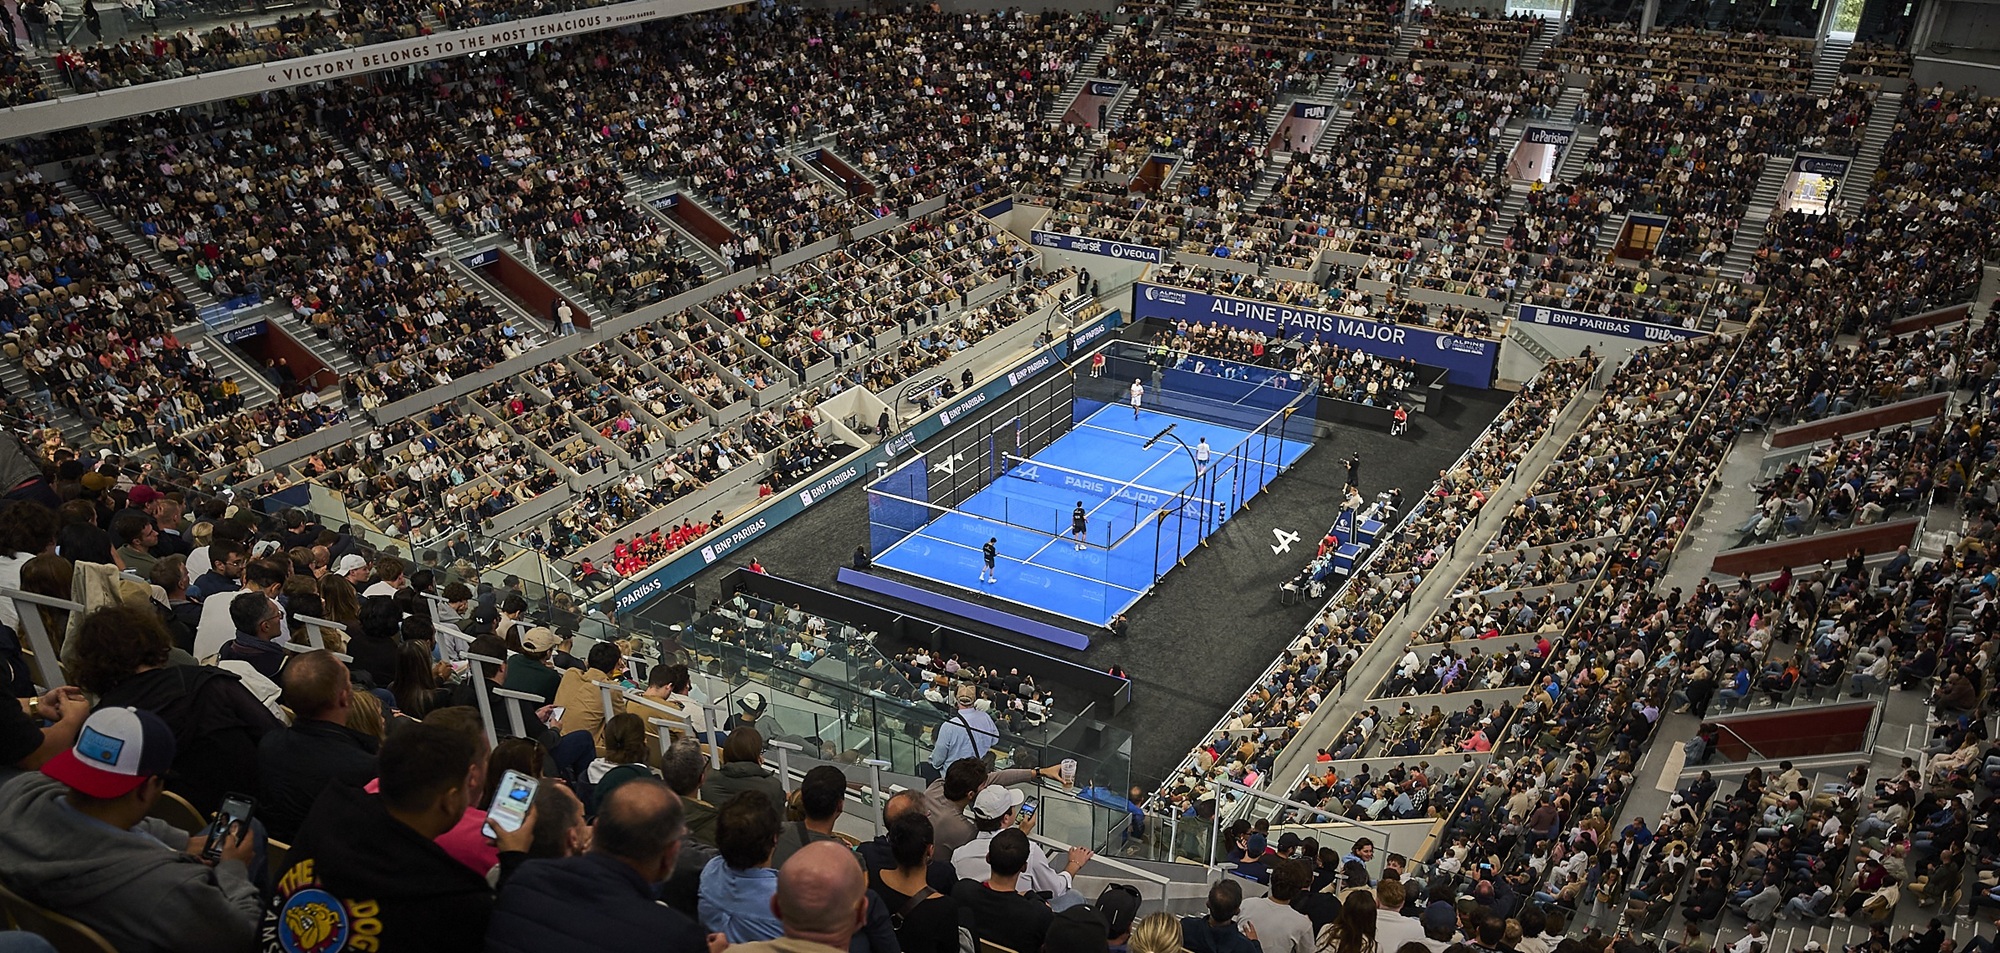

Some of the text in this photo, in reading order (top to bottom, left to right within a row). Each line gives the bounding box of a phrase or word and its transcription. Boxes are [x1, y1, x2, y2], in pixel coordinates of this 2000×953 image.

[282, 58, 355, 82] VICTORY
[362, 45, 430, 68] BELONGS
[436, 41, 454, 54] TO
[459, 35, 486, 49] THE
[492, 28, 526, 44] MOST
[531, 15, 602, 37] TENACIOUS
[1304, 106, 1325, 118] FUN
[1531, 129, 1569, 145] Le Parisien
[471, 253, 485, 267] FUN
[1123, 248, 1157, 261] VEOLIA
[1159, 290, 1187, 298] ALPINE
[1211, 298, 1406, 345] ALPINE PARIS MAJOR
[1552, 313, 1631, 334] BNP PARIBAS
[1453, 339, 1485, 347] ALPINE
[1015, 355, 1049, 381] BNP PARIBAS
[948, 392, 986, 420] BNP PARIBAS
[810, 466, 857, 499] BNP PARIBAS
[1064, 475, 1104, 493] PARIS
[1110, 486, 1159, 505] MAJOR
[714, 517, 767, 555] BNP PARIBAS
[621, 578, 662, 608] PARIBAS
[278, 858, 315, 899] THE
